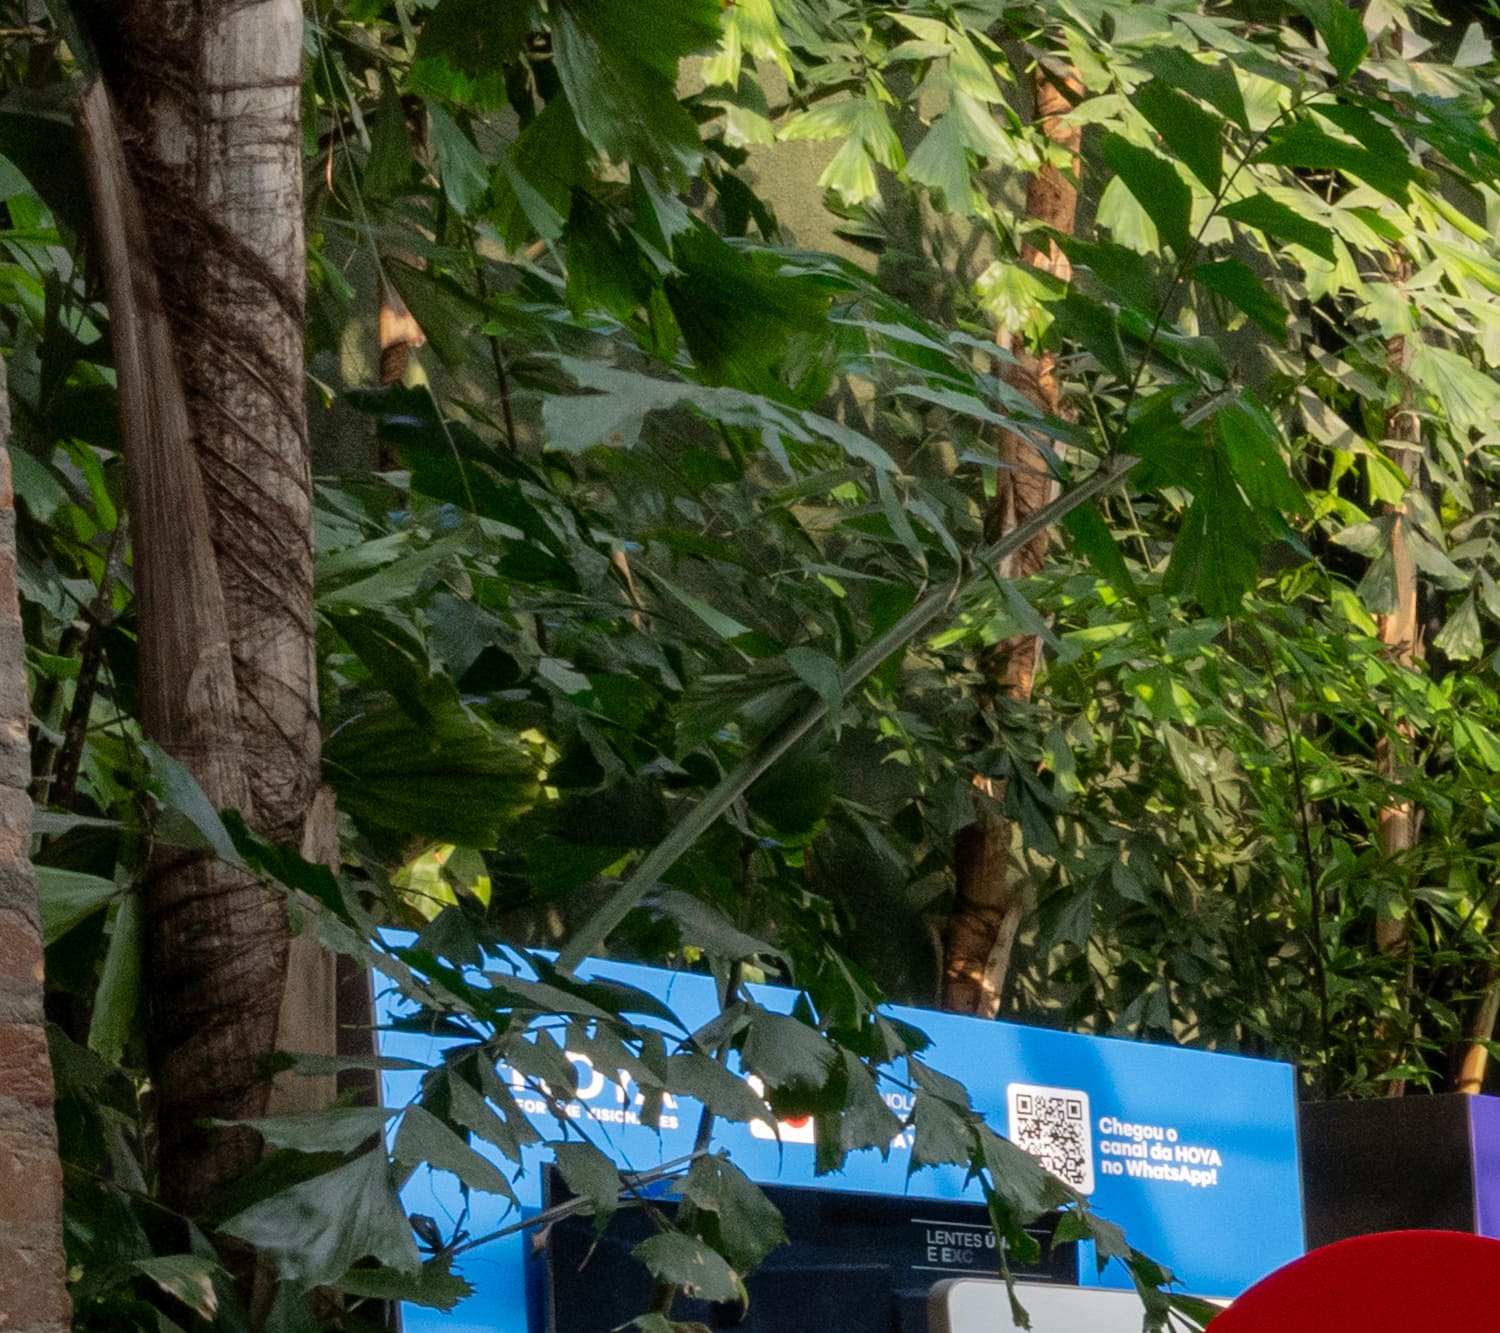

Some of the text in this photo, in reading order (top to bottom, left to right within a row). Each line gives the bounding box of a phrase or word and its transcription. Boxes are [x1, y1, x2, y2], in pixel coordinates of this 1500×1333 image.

[1099, 1117, 1179, 1143] Chegou o
[1101, 1138, 1223, 1168] canal da HOYA
[1101, 1160, 1218, 1188] no WhatsApp!
[926, 1229, 983, 1249] LENTES
[927, 1246, 939, 1263] E
